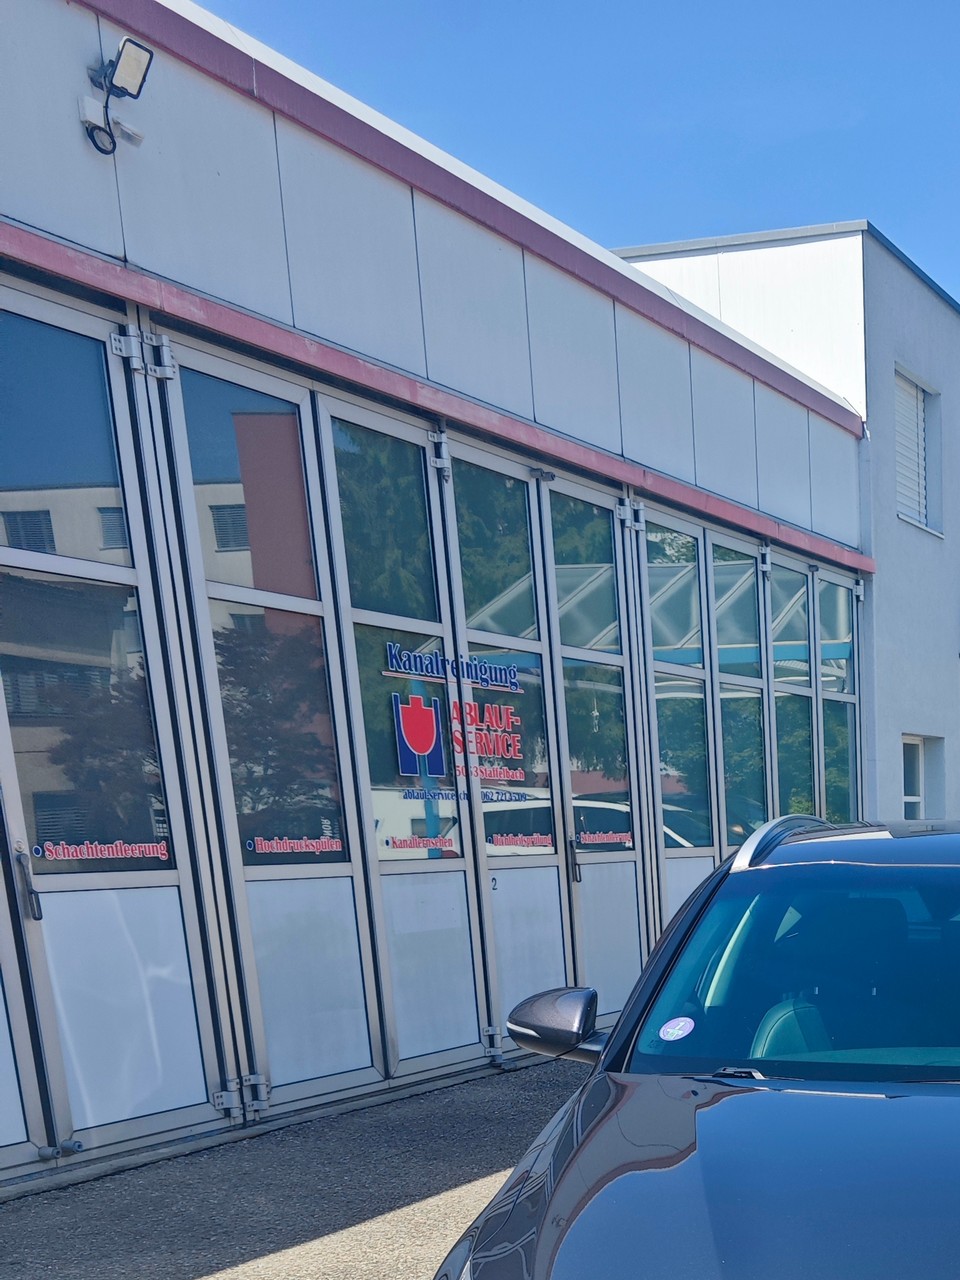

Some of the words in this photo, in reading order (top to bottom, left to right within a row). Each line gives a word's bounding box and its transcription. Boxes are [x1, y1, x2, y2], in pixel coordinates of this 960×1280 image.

[386, 642, 518, 690] Kanalreinigung
[452, 700, 521, 731] ABLAUF-
[453, 729, 523, 760] SERVICE
[403, 789, 470, 801] ablauf-servicech
[44, 840, 169, 861] Schachtentleerung
[491, 877, 498, 890] 2
